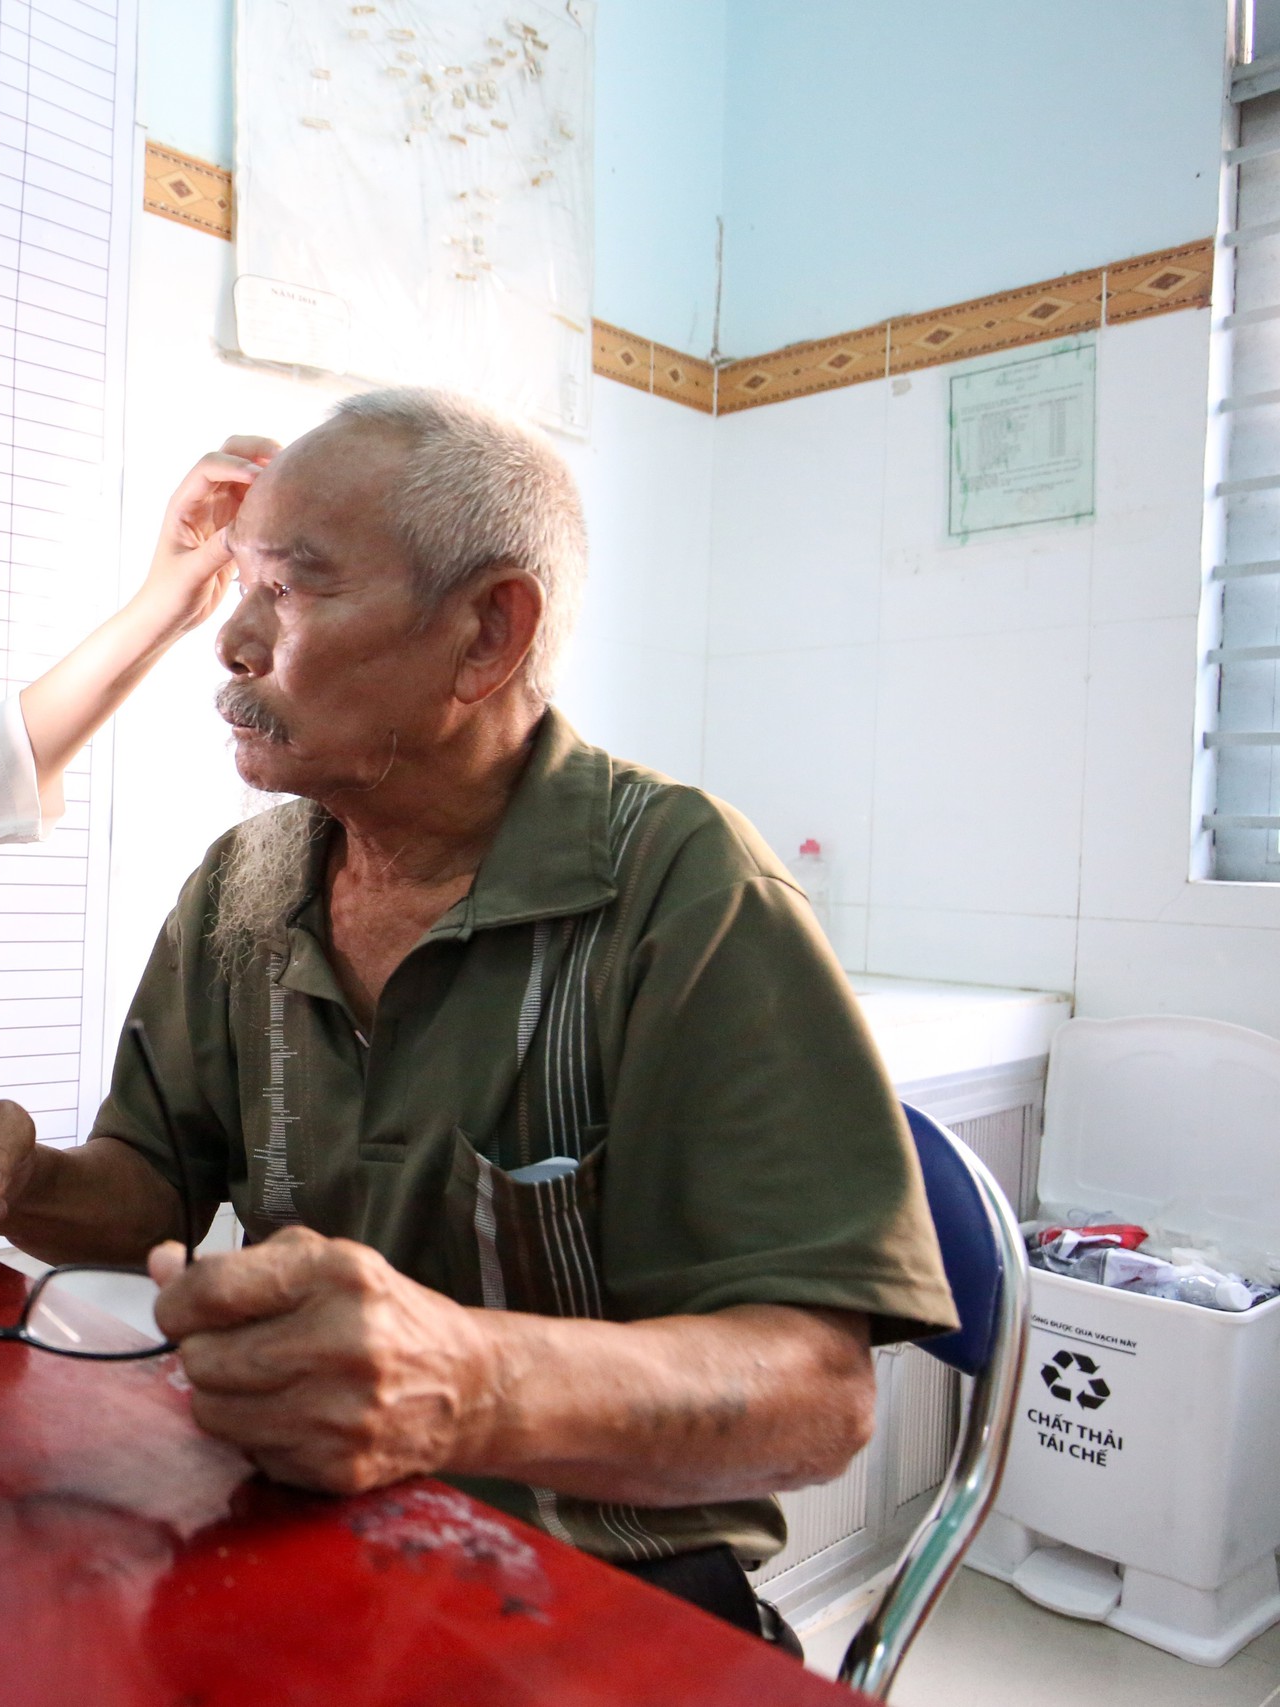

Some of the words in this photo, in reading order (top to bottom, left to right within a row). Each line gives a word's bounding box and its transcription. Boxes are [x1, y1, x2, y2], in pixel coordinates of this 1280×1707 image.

[1050, 1319, 1073, 1333] ĐƯỢC
[1074, 1326, 1093, 1338] QUA
[1094, 1332, 1118, 1345] VẠCH
[1119, 1337, 1137, 1348] NÀY
[1027, 1408, 1073, 1434] CHẤT
[1077, 1424, 1123, 1450] THẢI
[1038, 1432, 1064, 1453] TÁI
[1069, 1444, 1108, 1467] CHẾ
